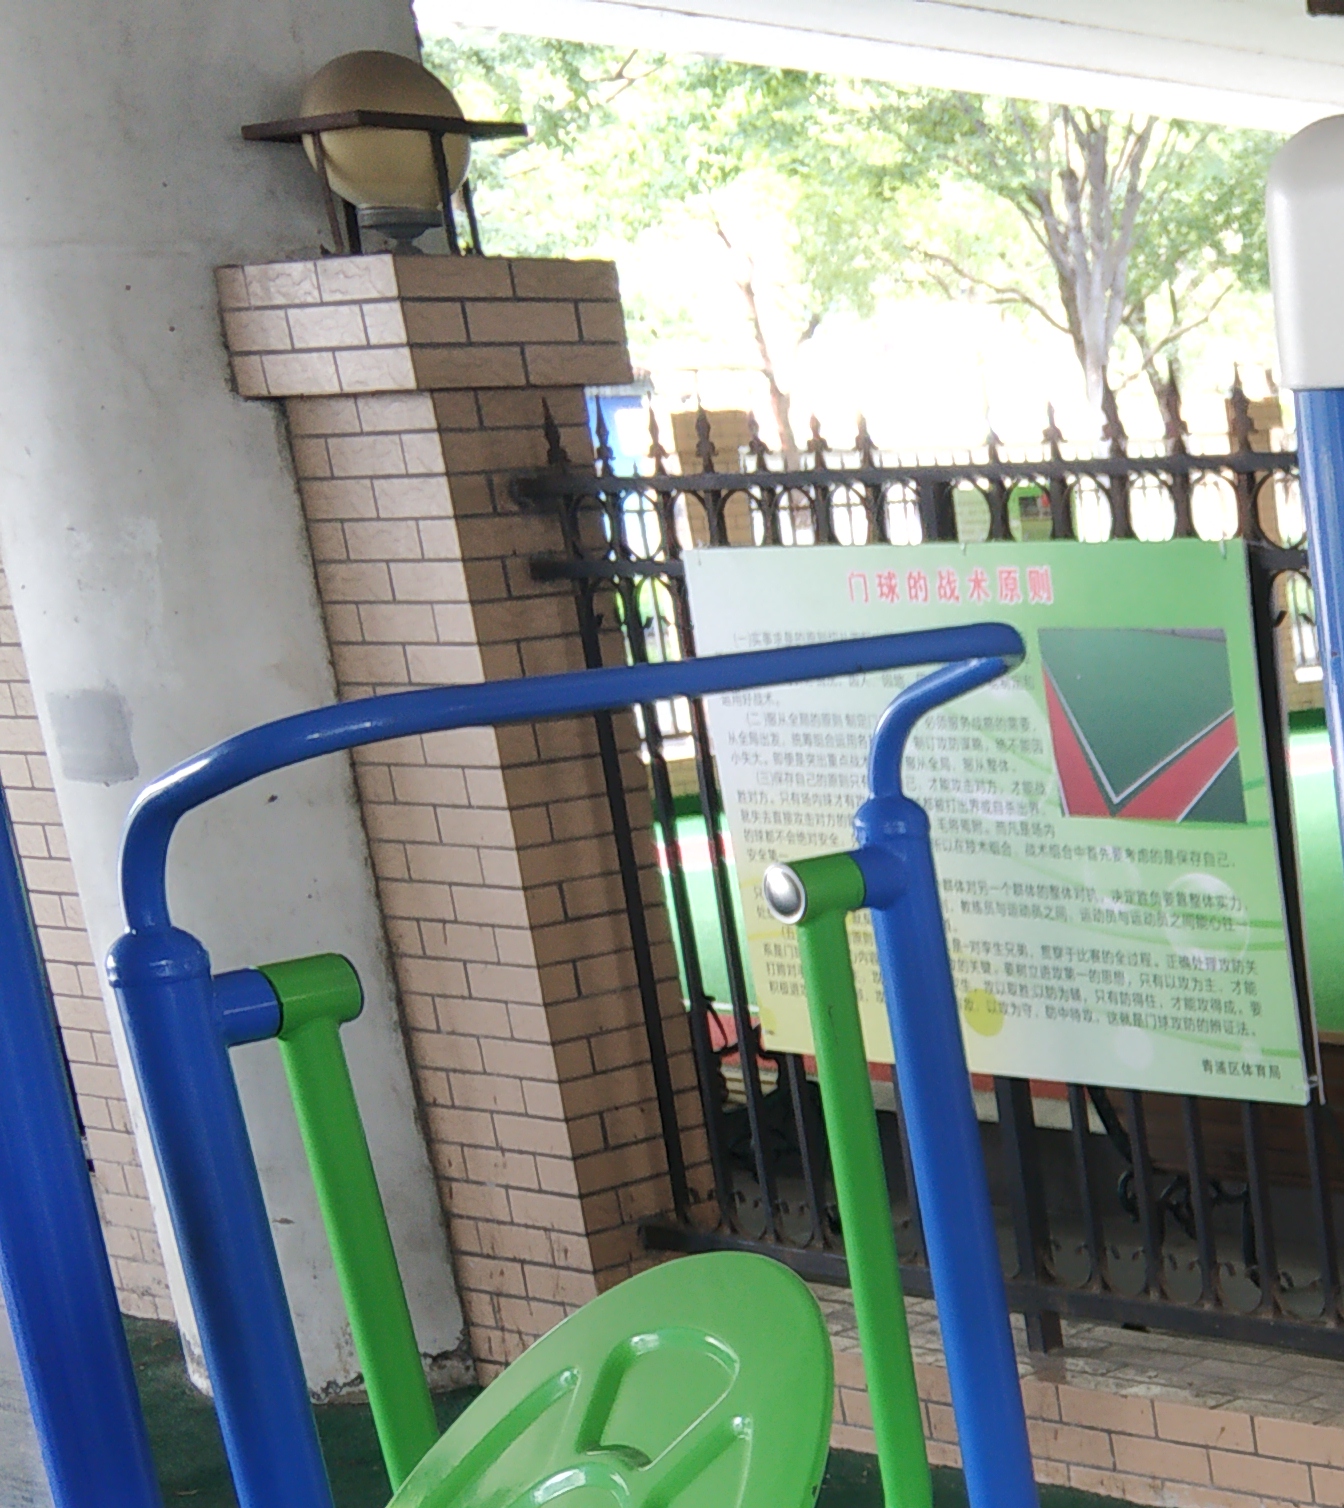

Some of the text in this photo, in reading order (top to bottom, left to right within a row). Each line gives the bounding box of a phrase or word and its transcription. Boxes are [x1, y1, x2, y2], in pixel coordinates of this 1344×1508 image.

[848, 566, 1053, 603] 门球的战术原则
